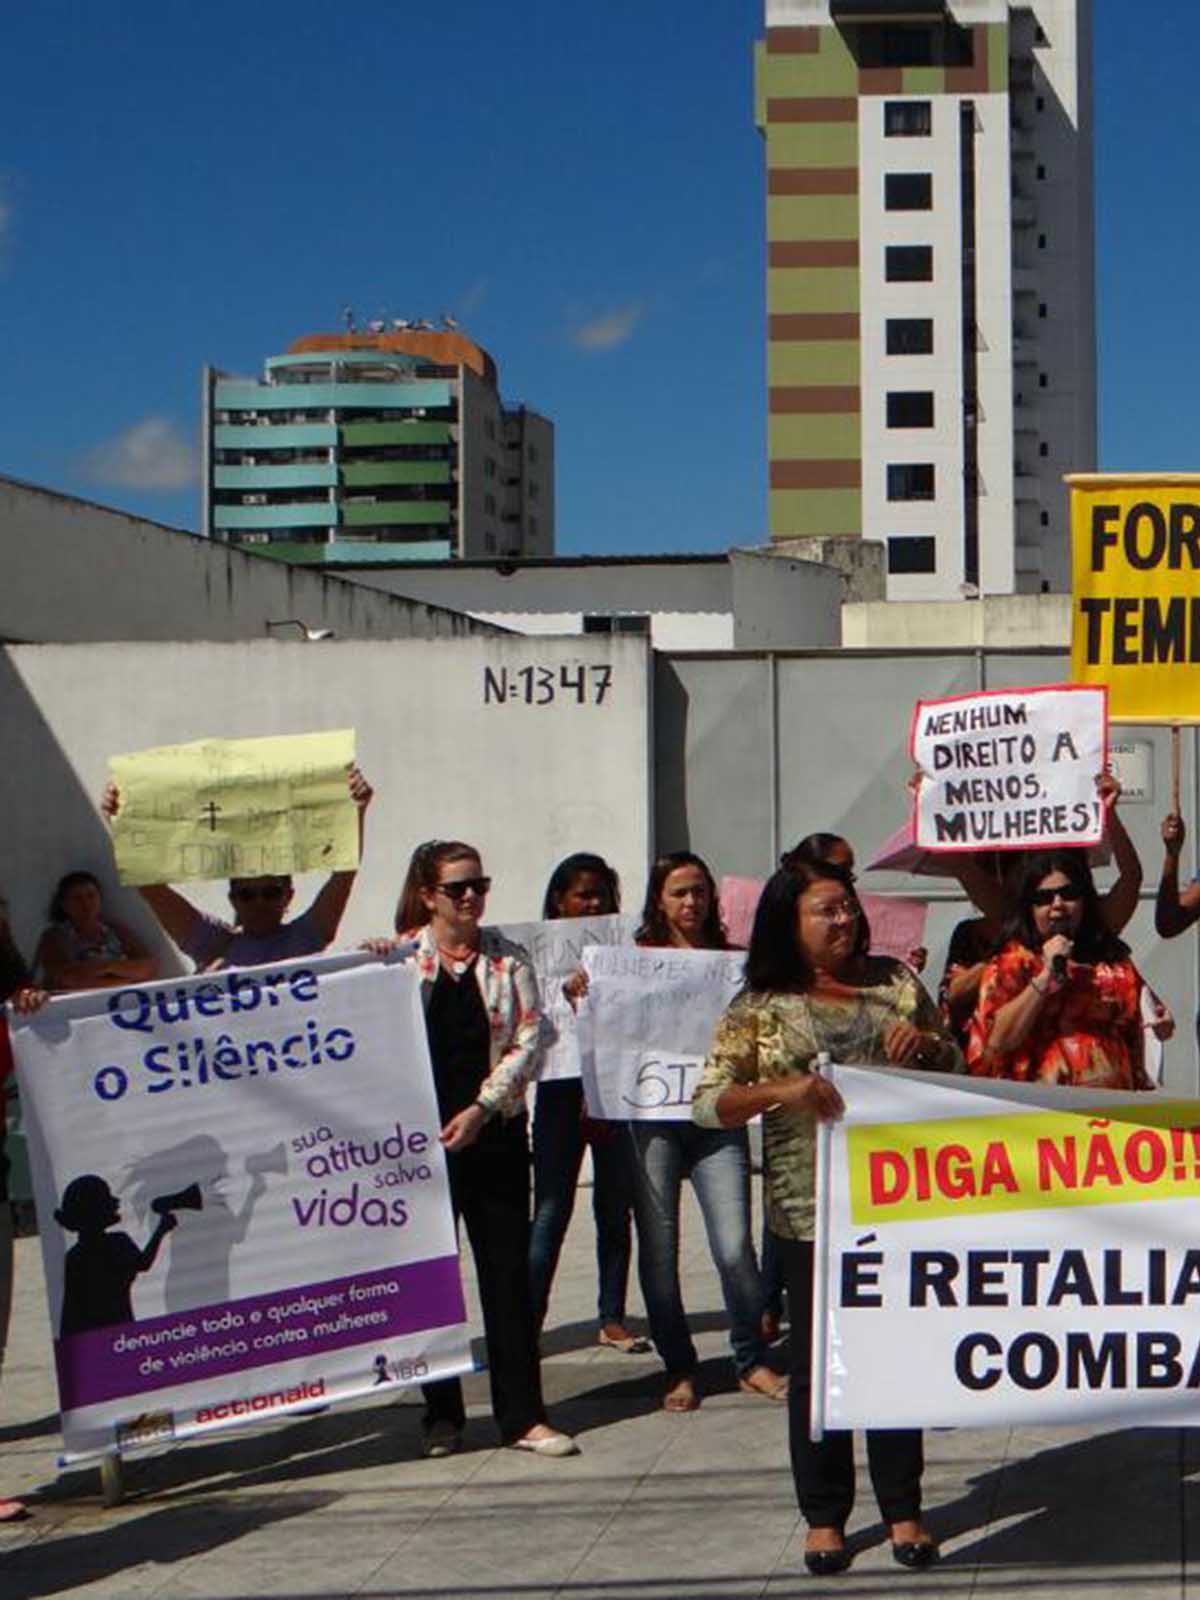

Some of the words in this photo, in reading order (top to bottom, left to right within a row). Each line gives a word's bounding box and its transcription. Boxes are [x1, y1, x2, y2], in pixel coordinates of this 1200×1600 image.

[924, 702, 1028, 737] NENHUM
[1051, 731, 1079, 763] A
[933, 801, 1100, 843] MULHERES!
[107, 969, 319, 1033] Quebre
[94, 1065, 129, 1101] o
[143, 1019, 356, 1094] Silêncio
[291, 1126, 333, 1153] sua
[306, 1121, 429, 1178] atitude
[373, 1163, 432, 1189] salva
[867, 1141, 1020, 1206] DIGA
[291, 1183, 409, 1227] vidas
[840, 1233, 884, 1308] É
[113, 1322, 198, 1353] denuncie
[201, 1311, 245, 1333] toda
[249, 1311, 262, 1324] e
[267, 1294, 344, 1323] qualquer
[349, 1281, 400, 1302] forma
[138, 1355, 165, 1376] de
[169, 1340, 248, 1368] violência
[253, 1328, 308, 1349] contra
[313, 1310, 389, 1337] mulheres
[194, 1377, 326, 1424] actionaid
